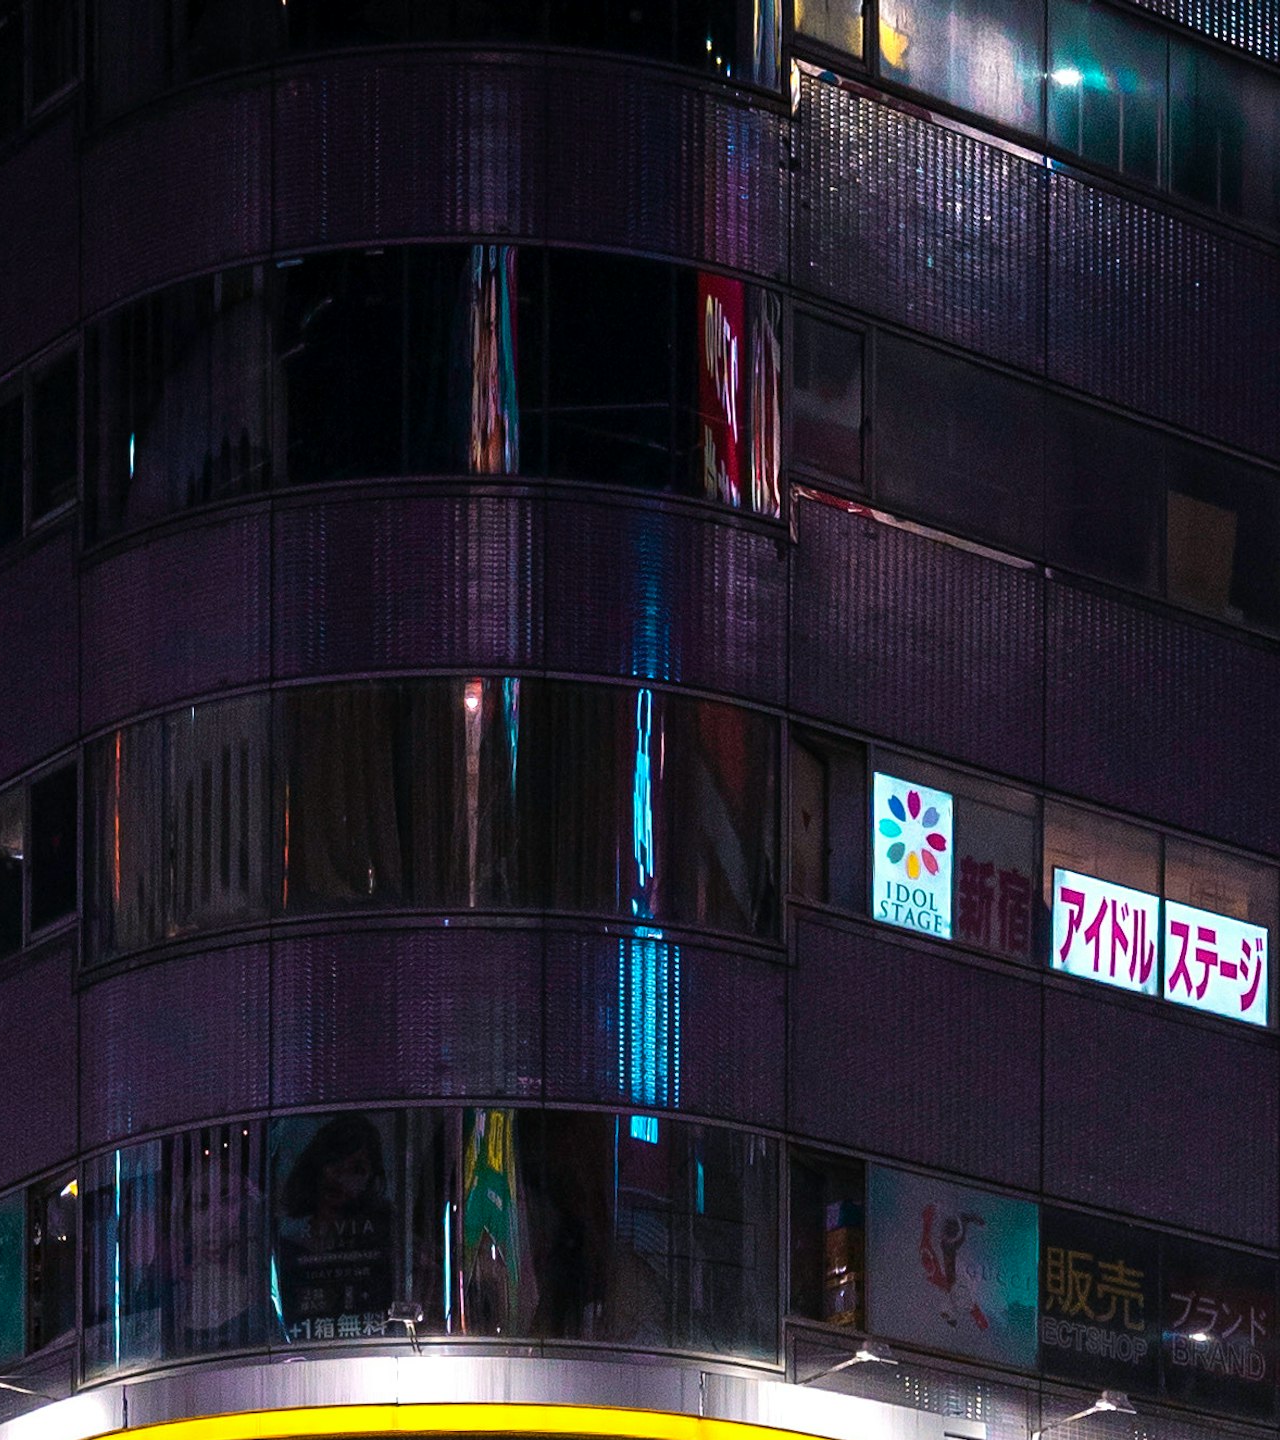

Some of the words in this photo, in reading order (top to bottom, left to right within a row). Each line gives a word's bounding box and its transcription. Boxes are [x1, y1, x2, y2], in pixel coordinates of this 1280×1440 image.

[879, 898, 944, 935] STAGE
[885, 879, 939, 914] IDOL
[1059, 885, 1155, 987] アイドル
[1168, 919, 1264, 1014] ステージ
[1044, 1246, 1145, 1332] 販売
[1169, 1291, 1267, 1347] ブランド
[1170, 1335, 1267, 1381] BRAND
